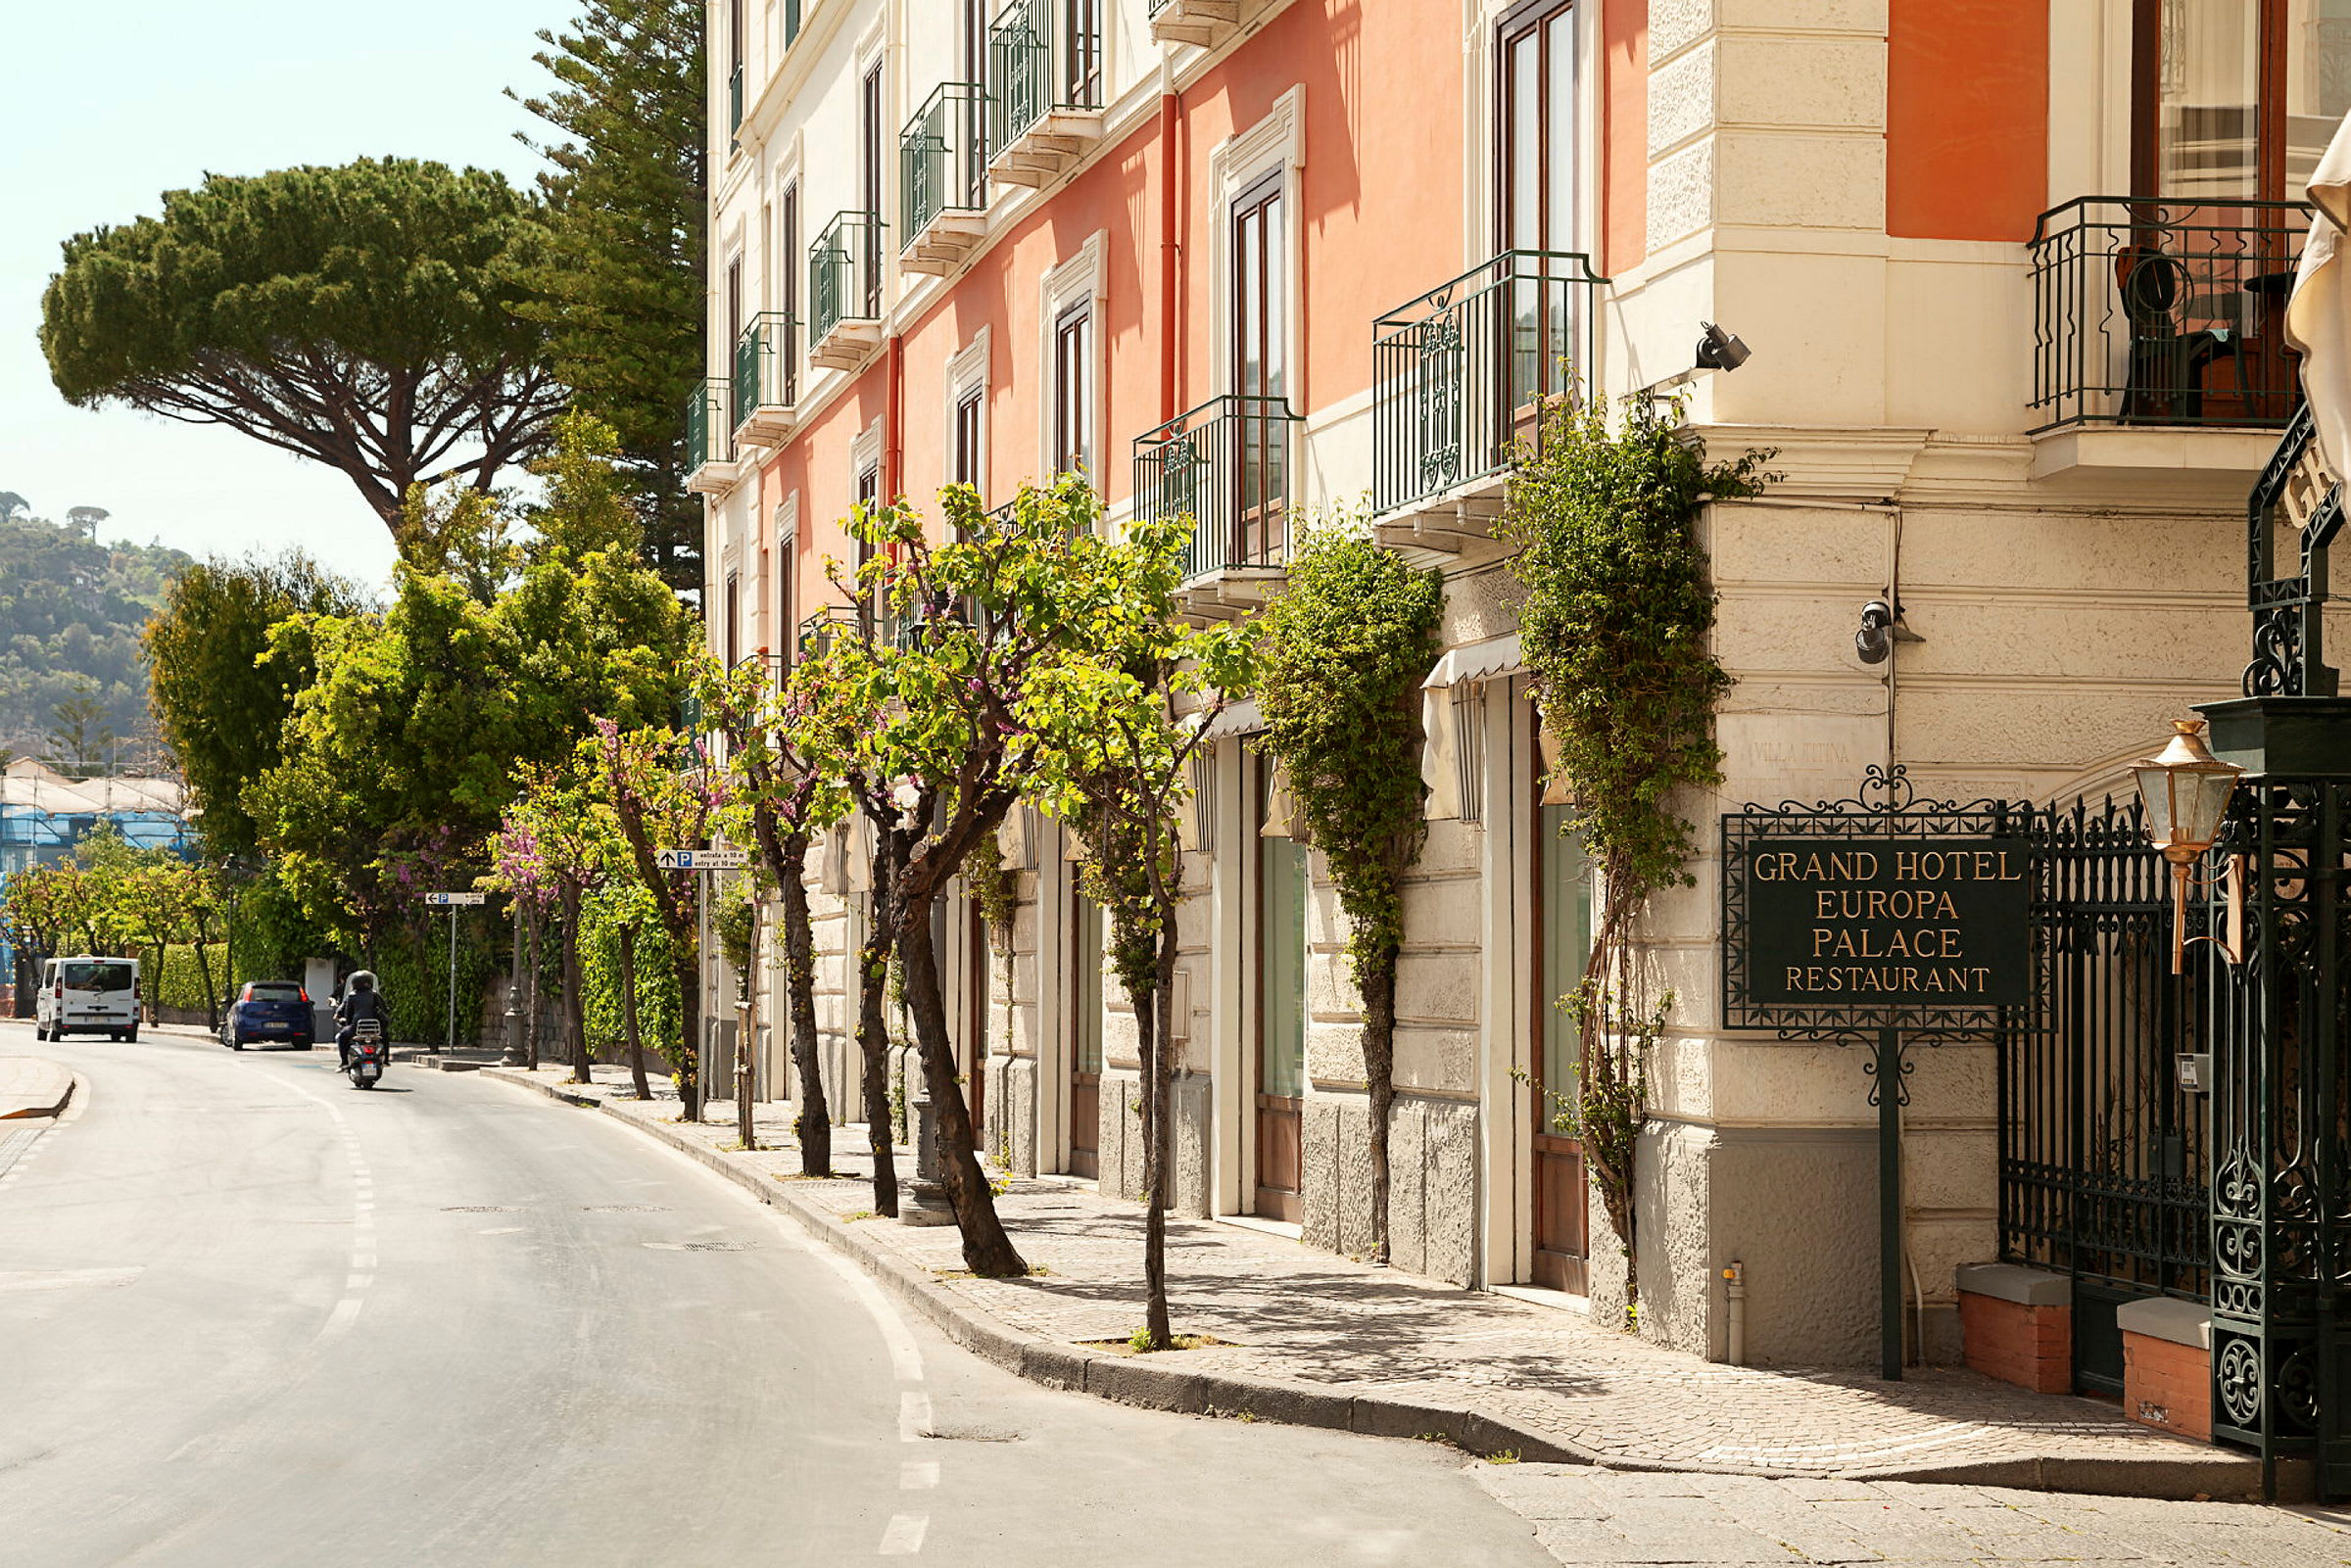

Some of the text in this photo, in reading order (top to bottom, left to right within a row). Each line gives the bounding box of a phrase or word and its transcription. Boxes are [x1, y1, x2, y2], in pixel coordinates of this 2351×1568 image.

[1754, 851, 2022, 880] GRAND HOTEL
[1815, 890, 1959, 919] EUROPA
[1812, 928, 1963, 958] PALACE
[1785, 967, 1990, 992] RESTAURANT
